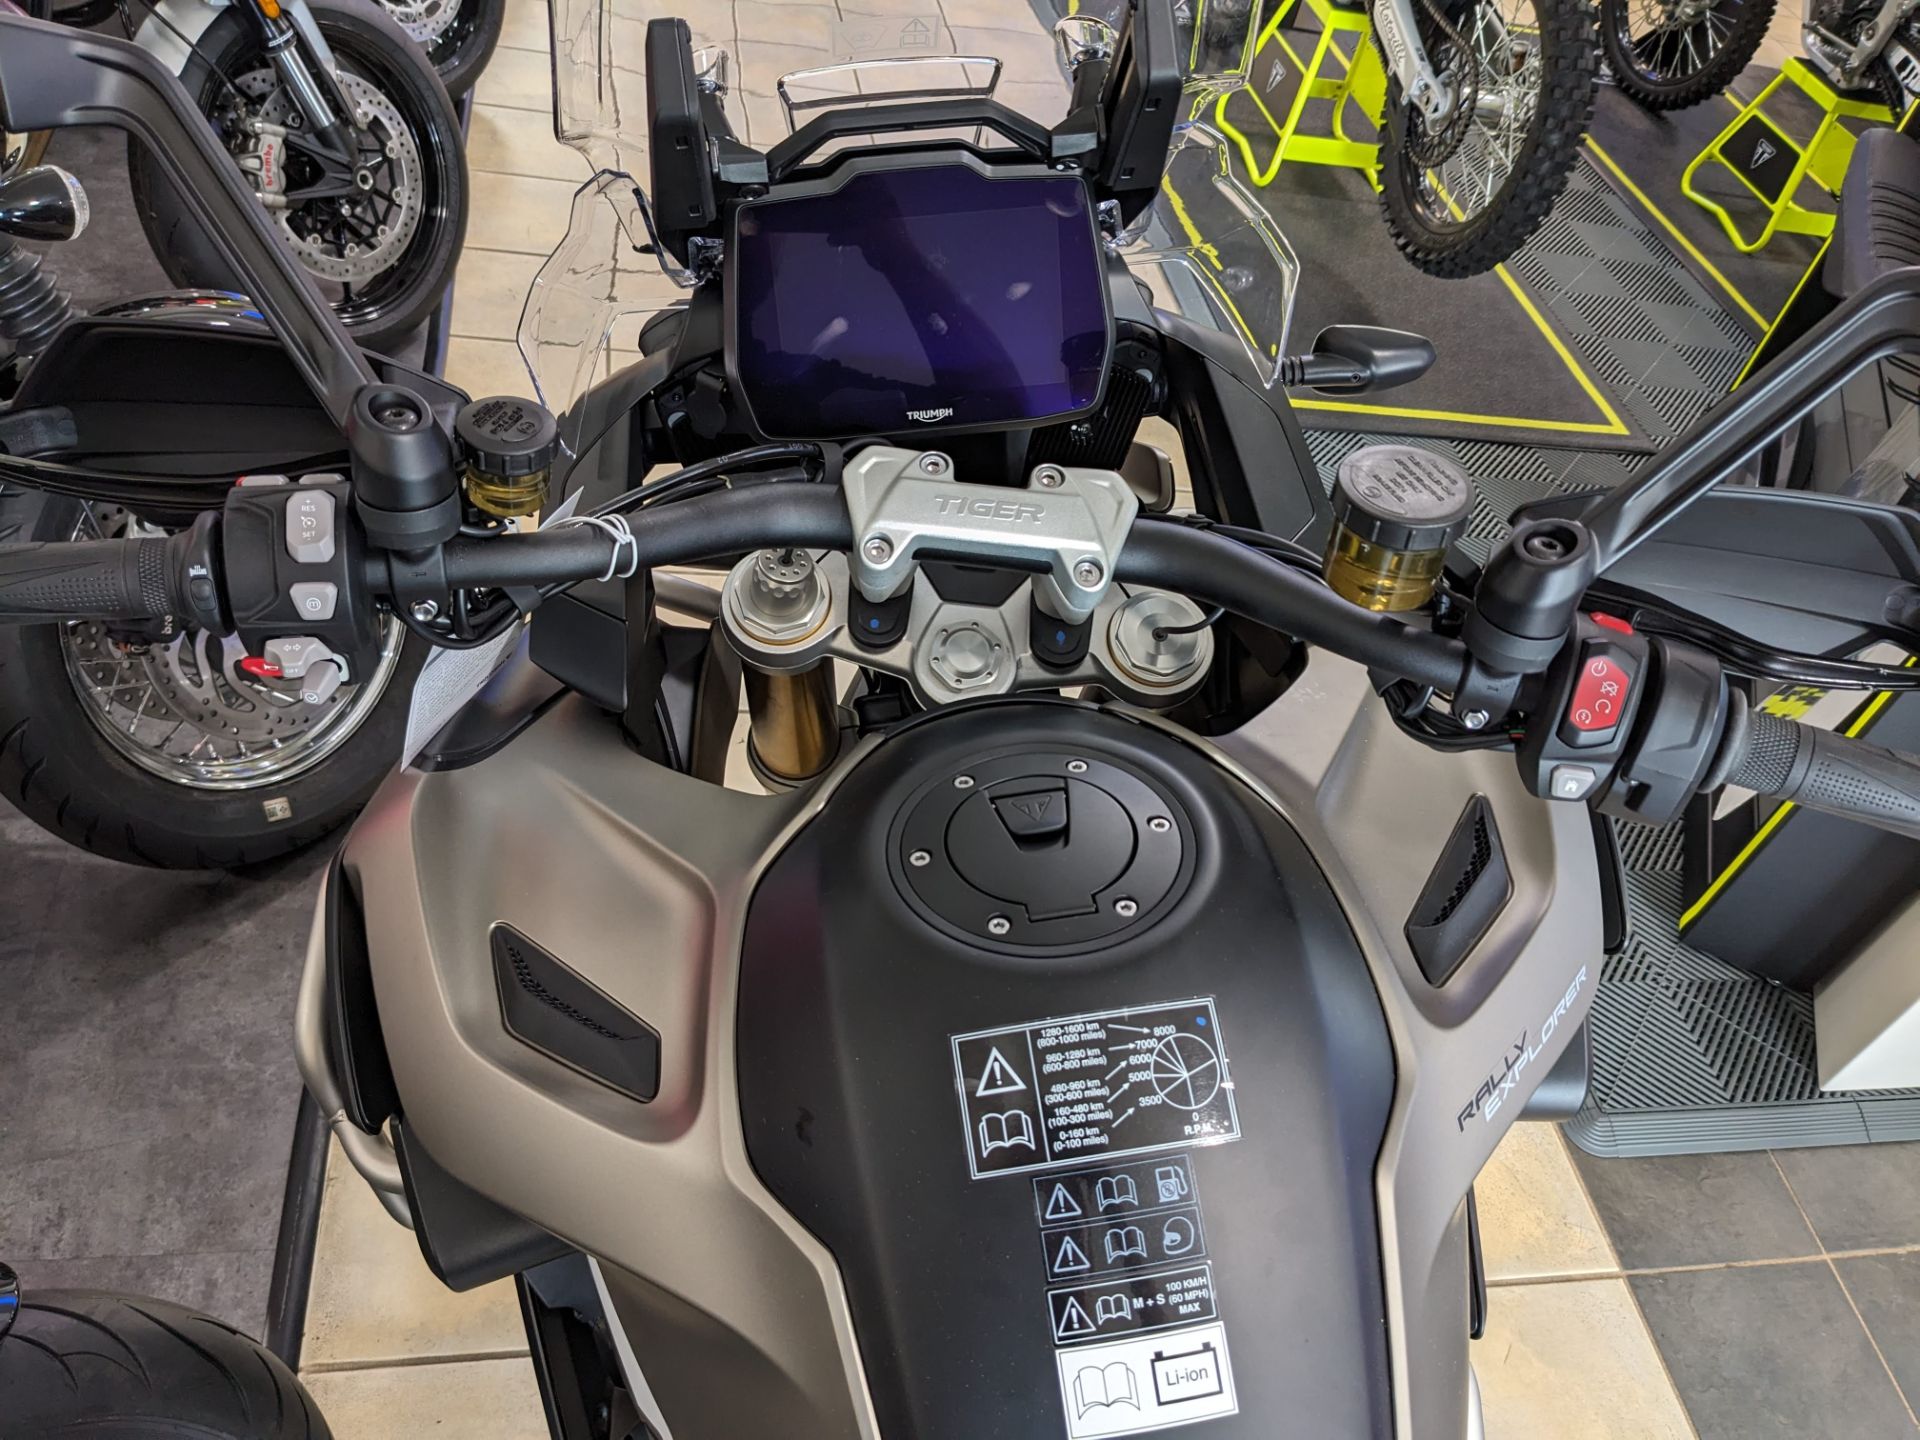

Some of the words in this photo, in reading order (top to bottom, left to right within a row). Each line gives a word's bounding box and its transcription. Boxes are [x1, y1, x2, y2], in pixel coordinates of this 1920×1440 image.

[263, 143, 274, 187] brembo
[906, 407, 953, 421] TRIUMPH
[301, 504, 316, 512] RES
[934, 494, 1046, 524] TIGER
[1040, 1023, 1083, 1038] 1280-1600
[1083, 1022, 1100, 1032] km
[1153, 1025, 1176, 1036] 8000
[1037, 1033, 1078, 1050] (800-1000
[1080, 1029, 1106, 1042] miles)
[1135, 1038, 1159, 1050] 7000
[1484, 964, 1587, 1123] EXPLORER
[1046, 1049, 1085, 1063] 960-1280
[1086, 1047, 1101, 1057] km
[1128, 1053, 1152, 1065] 6000
[1042, 1058, 1080, 1075] (600-800
[1081, 1055, 1107, 1068] miles)
[1128, 1071, 1152, 1082] 5000
[1457, 1030, 1527, 1132] RALLY
[1050, 1080, 1085, 1093] 480-960
[1086, 1078, 1101, 1088] km
[1044, 1090, 1082, 1105] (300-600
[1083, 1086, 1110, 1099] miles)
[1138, 1094, 1163, 1107] 3500
[1054, 1103, 1089, 1117] 160-480
[1090, 1101, 1104, 1111] km
[1191, 1112, 1200, 1122] 0
[1047, 1113, 1085, 1129] (100-300
[1086, 1109, 1113, 1123] miles)
[1059, 1128, 1083, 1140] 0-160
[1085, 1126, 1099, 1136] km
[1053, 1138, 1082, 1152] (0-100
[1083, 1134, 1109, 1147] miles)
[1165, 1282, 1182, 1292] 100
[1183, 1276, 1208, 1289] KM/H
[1132, 1297, 1144, 1309] M
[1145, 1298, 1155, 1307] +
[1156, 1293, 1166, 1304] S
[1168, 1293, 1184, 1306] (60
[1184, 1288, 1209, 1302] MPH)
[1178, 1302, 1201, 1315] MAX
[1165, 1367, 1209, 1386] Li-ion
